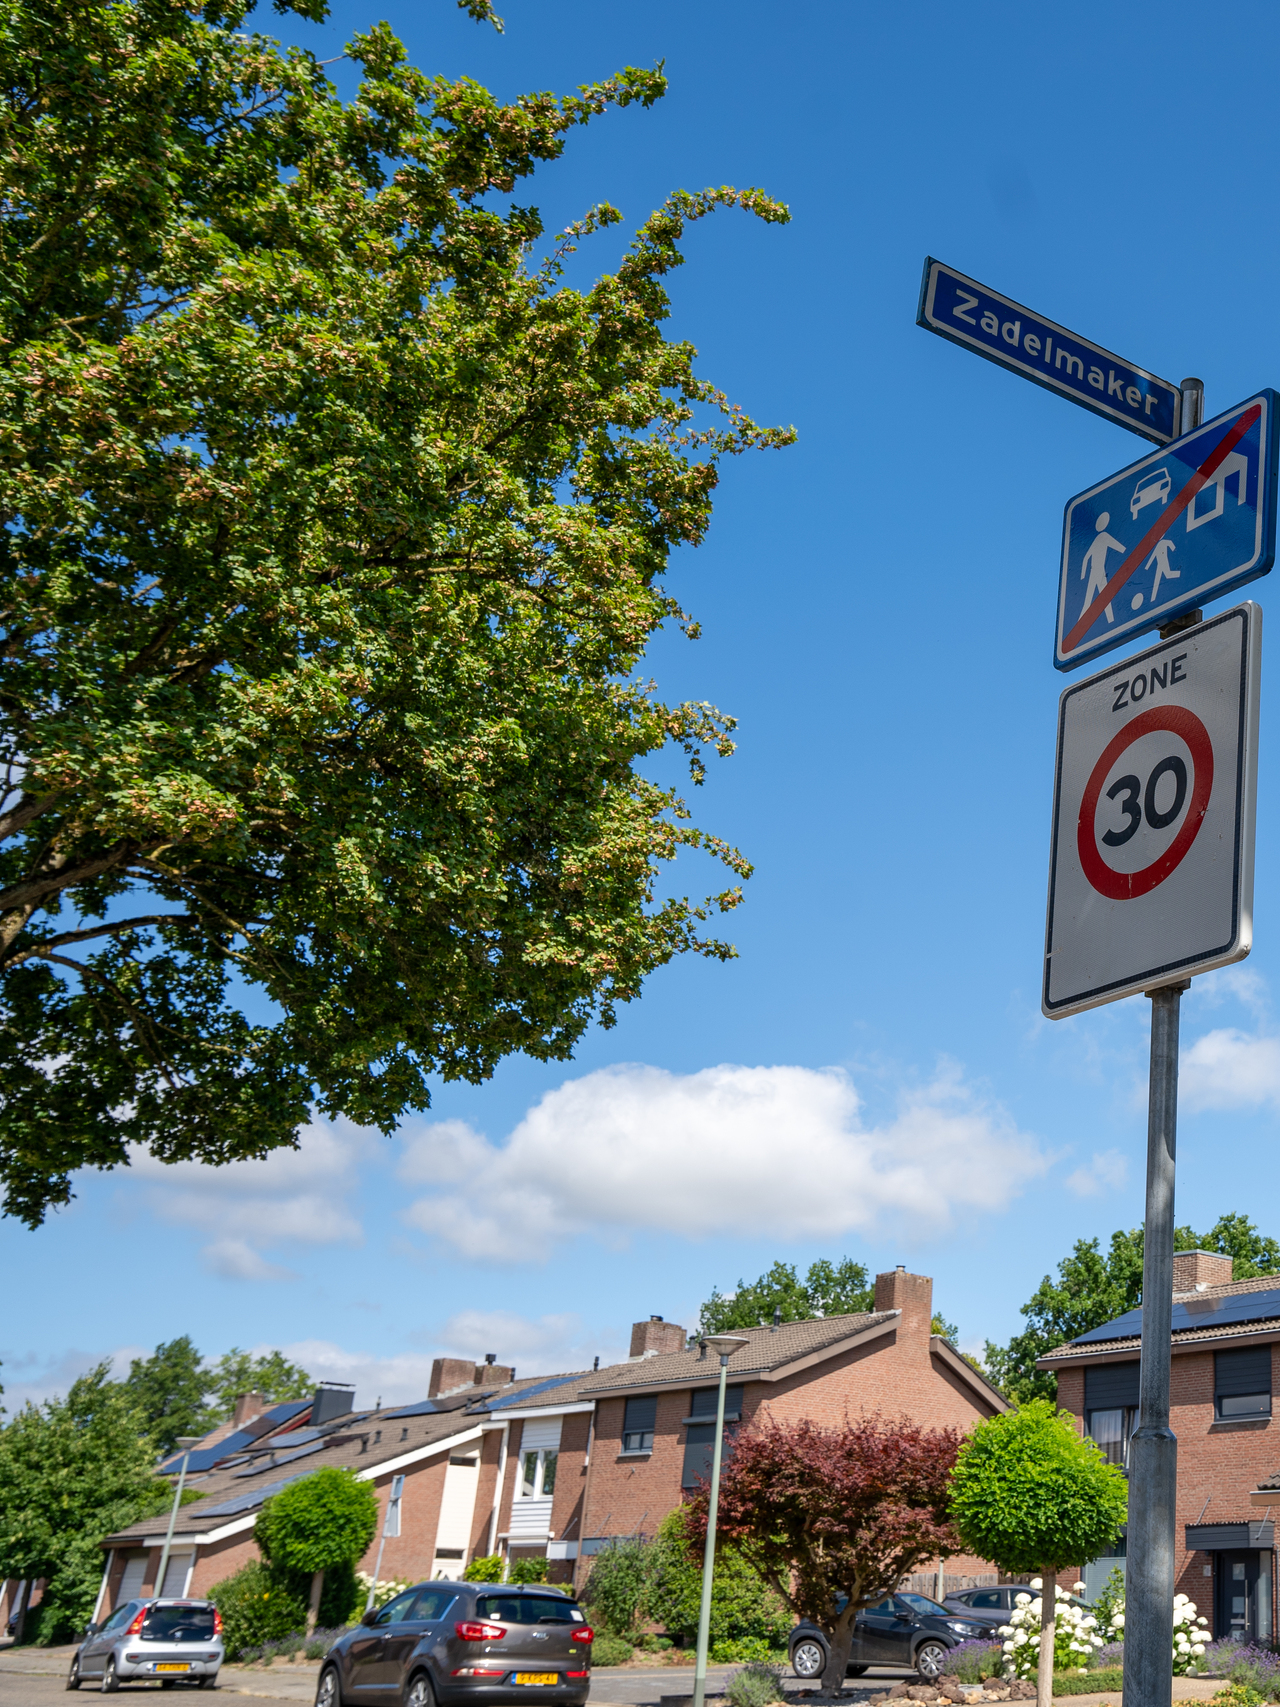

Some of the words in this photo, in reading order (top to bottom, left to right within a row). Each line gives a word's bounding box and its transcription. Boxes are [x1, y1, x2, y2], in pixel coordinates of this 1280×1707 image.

[953, 288, 1158, 415] Zadelmaker
[1112, 652, 1187, 712] ZONE
[1101, 755, 1187, 847] 30
